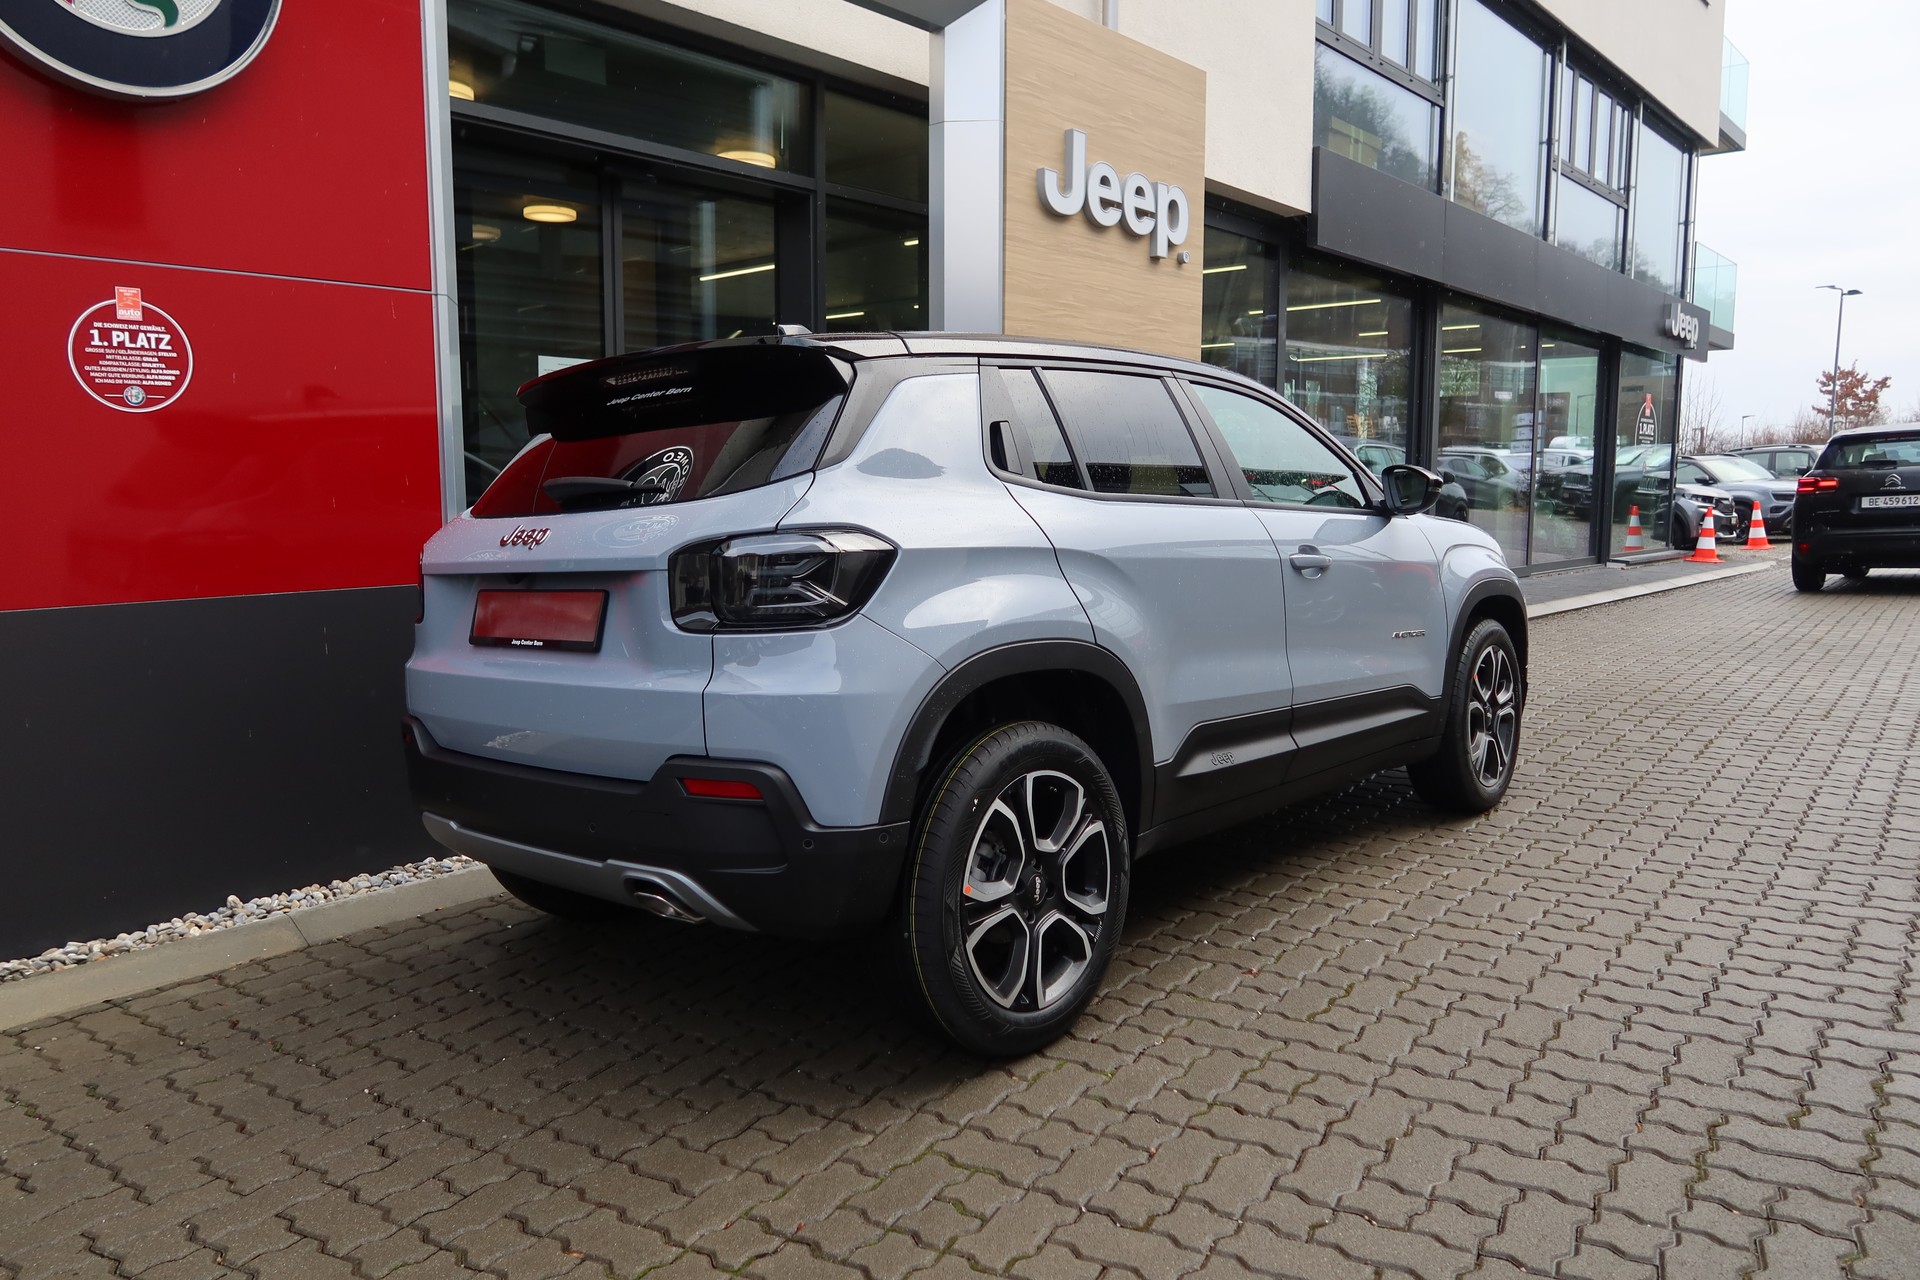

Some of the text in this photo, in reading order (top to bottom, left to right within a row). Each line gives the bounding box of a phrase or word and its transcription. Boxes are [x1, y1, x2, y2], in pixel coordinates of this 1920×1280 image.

[1036, 128, 1189, 259] Jeep
[118, 309, 141, 317] auto
[103, 322, 128, 330] SCHWEIZ
[1665, 302, 1699, 349] Jeep
[89, 329, 173, 350] 1. PLATZ
[606, 387, 693, 406] Jeep Center Bern
[500, 524, 552, 551] Jeep
[1210, 751, 1235, 766] Jeep
[1033, 876, 1042, 902] Jeep
